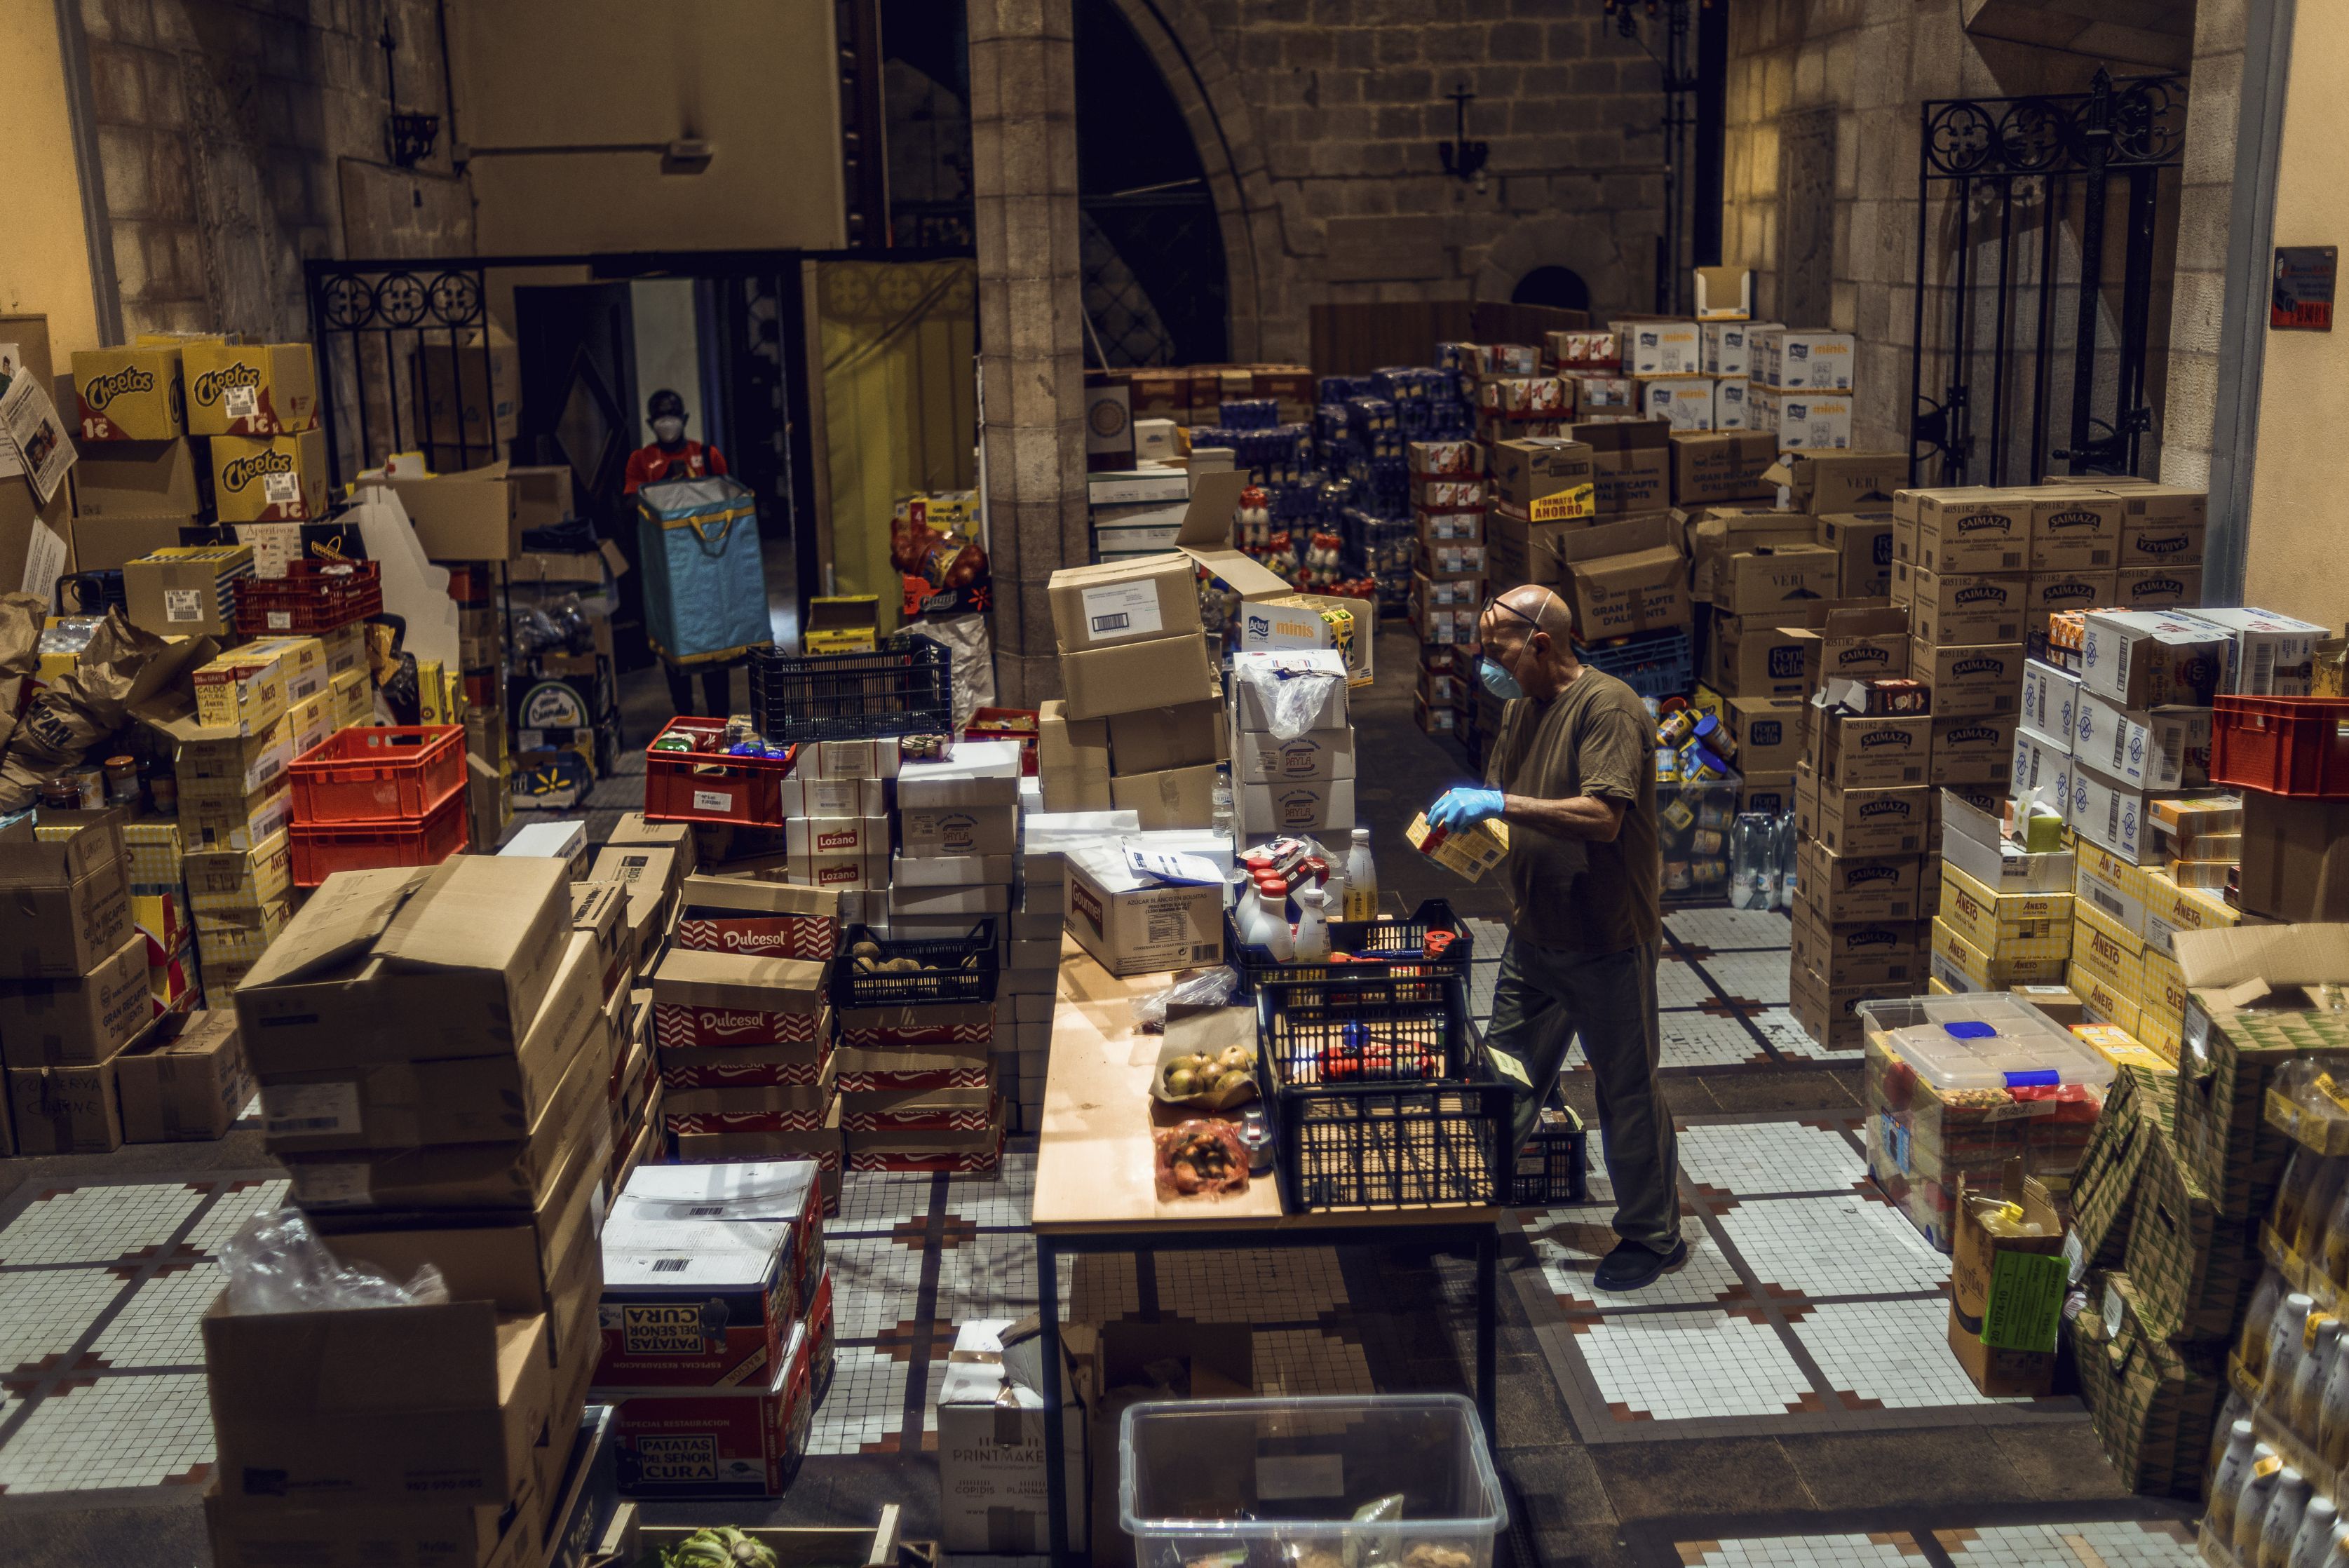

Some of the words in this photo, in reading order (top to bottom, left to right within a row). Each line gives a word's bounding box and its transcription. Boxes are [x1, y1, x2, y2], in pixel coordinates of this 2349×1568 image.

[1663, 334, 1693, 342] minis
[1814, 344, 1848, 353] minis
[86, 366, 154, 412] Cheetos
[194, 363, 260, 407] Cheetos
[1677, 390, 1707, 398] minis
[1813, 405, 1846, 414] minis
[222, 449, 293, 492] Cheetos
[1538, 496, 1573, 506] FORMATO
[2034, 501, 2065, 510] 4051182
[1535, 504, 1583, 519] AHORRO
[1942, 505, 1975, 514] 4051182
[1960, 515, 2009, 530] SAIMAZA
[2050, 513, 2098, 526] SAIMAZA
[2139, 539, 2187, 553] SAIMAZA
[2118, 569, 2148, 579] 4051182
[1940, 578, 1972, 587] 4051182
[2134, 581, 2181, 594] SAIMAZA
[1957, 588, 2004, 602] SAIMAZA
[2045, 585, 2092, 598] SAIMAZA
[1592, 604, 1623, 617] GRAN
[1626, 595, 1675, 611] RCAPTE
[1249, 619, 1268, 631] Arluy
[1276, 620, 1314, 638] minis
[1773, 649, 1804, 662] Font
[1841, 649, 1886, 662] SAIMAZA
[1938, 649, 1969, 658] 4051182
[1954, 660, 2001, 674] SAIMAZA
[208, 673, 225, 682] GRATIS
[197, 685, 226, 694] CALDO
[1754, 722, 1779, 734] Font
[1846, 721, 1878, 730] 4051182
[1863, 732, 1909, 745] SAIMAZA
[1949, 729, 1996, 742] SAIMAZA
[1285, 756, 1312, 766] PAYLA
[1845, 791, 1876, 800] 4051182
[1285, 807, 1311, 818] PAYLA
[1861, 802, 1908, 816] SAIMAZA
[820, 837, 855, 846] Lozano
[943, 832, 970, 842] PAYLA
[2099, 852, 2122, 880] ANTO
[821, 871, 857, 881] Lozano
[1850, 868, 1896, 881] SAIMAZA
[1072, 883, 1102, 923] Gourmet
[1127, 897, 1150, 906] AZÚCAR
[1956, 888, 1978, 921] ANETO
[2023, 901, 2048, 910] ANETO
[2174, 897, 2201, 927] ANETO
[723, 930, 786, 947] Dulcesol
[1848, 933, 1894, 945] SAIMAZA
[1947, 938, 1967, 964] ANETO
[2091, 930, 2120, 966] ANETO
[2012, 960, 2038, 970] ANETO
[2091, 984, 2113, 1013] ANETO
[699, 1011, 765, 1029] Dulcesol
[628, 1309, 697, 1323] CURA
[1994, 1290, 2008, 1329] 1074-10
[630, 1325, 677, 1339] SEÑOR
[678, 1325, 698, 1335] DEL
[1991, 1330, 1999, 1342] 20
[631, 1338, 698, 1349] PATATAS
[663, 1419, 730, 1428] RESTAURACION
[642, 1440, 710, 1452] PATATAS
[644, 1454, 663, 1464] DEL
[663, 1451, 711, 1464] SEÑOR
[952, 1449, 1045, 1463] PRINTMAKE
[645, 1466, 714, 1479] CURA
[954, 1486, 996, 1494] COPIDIS
